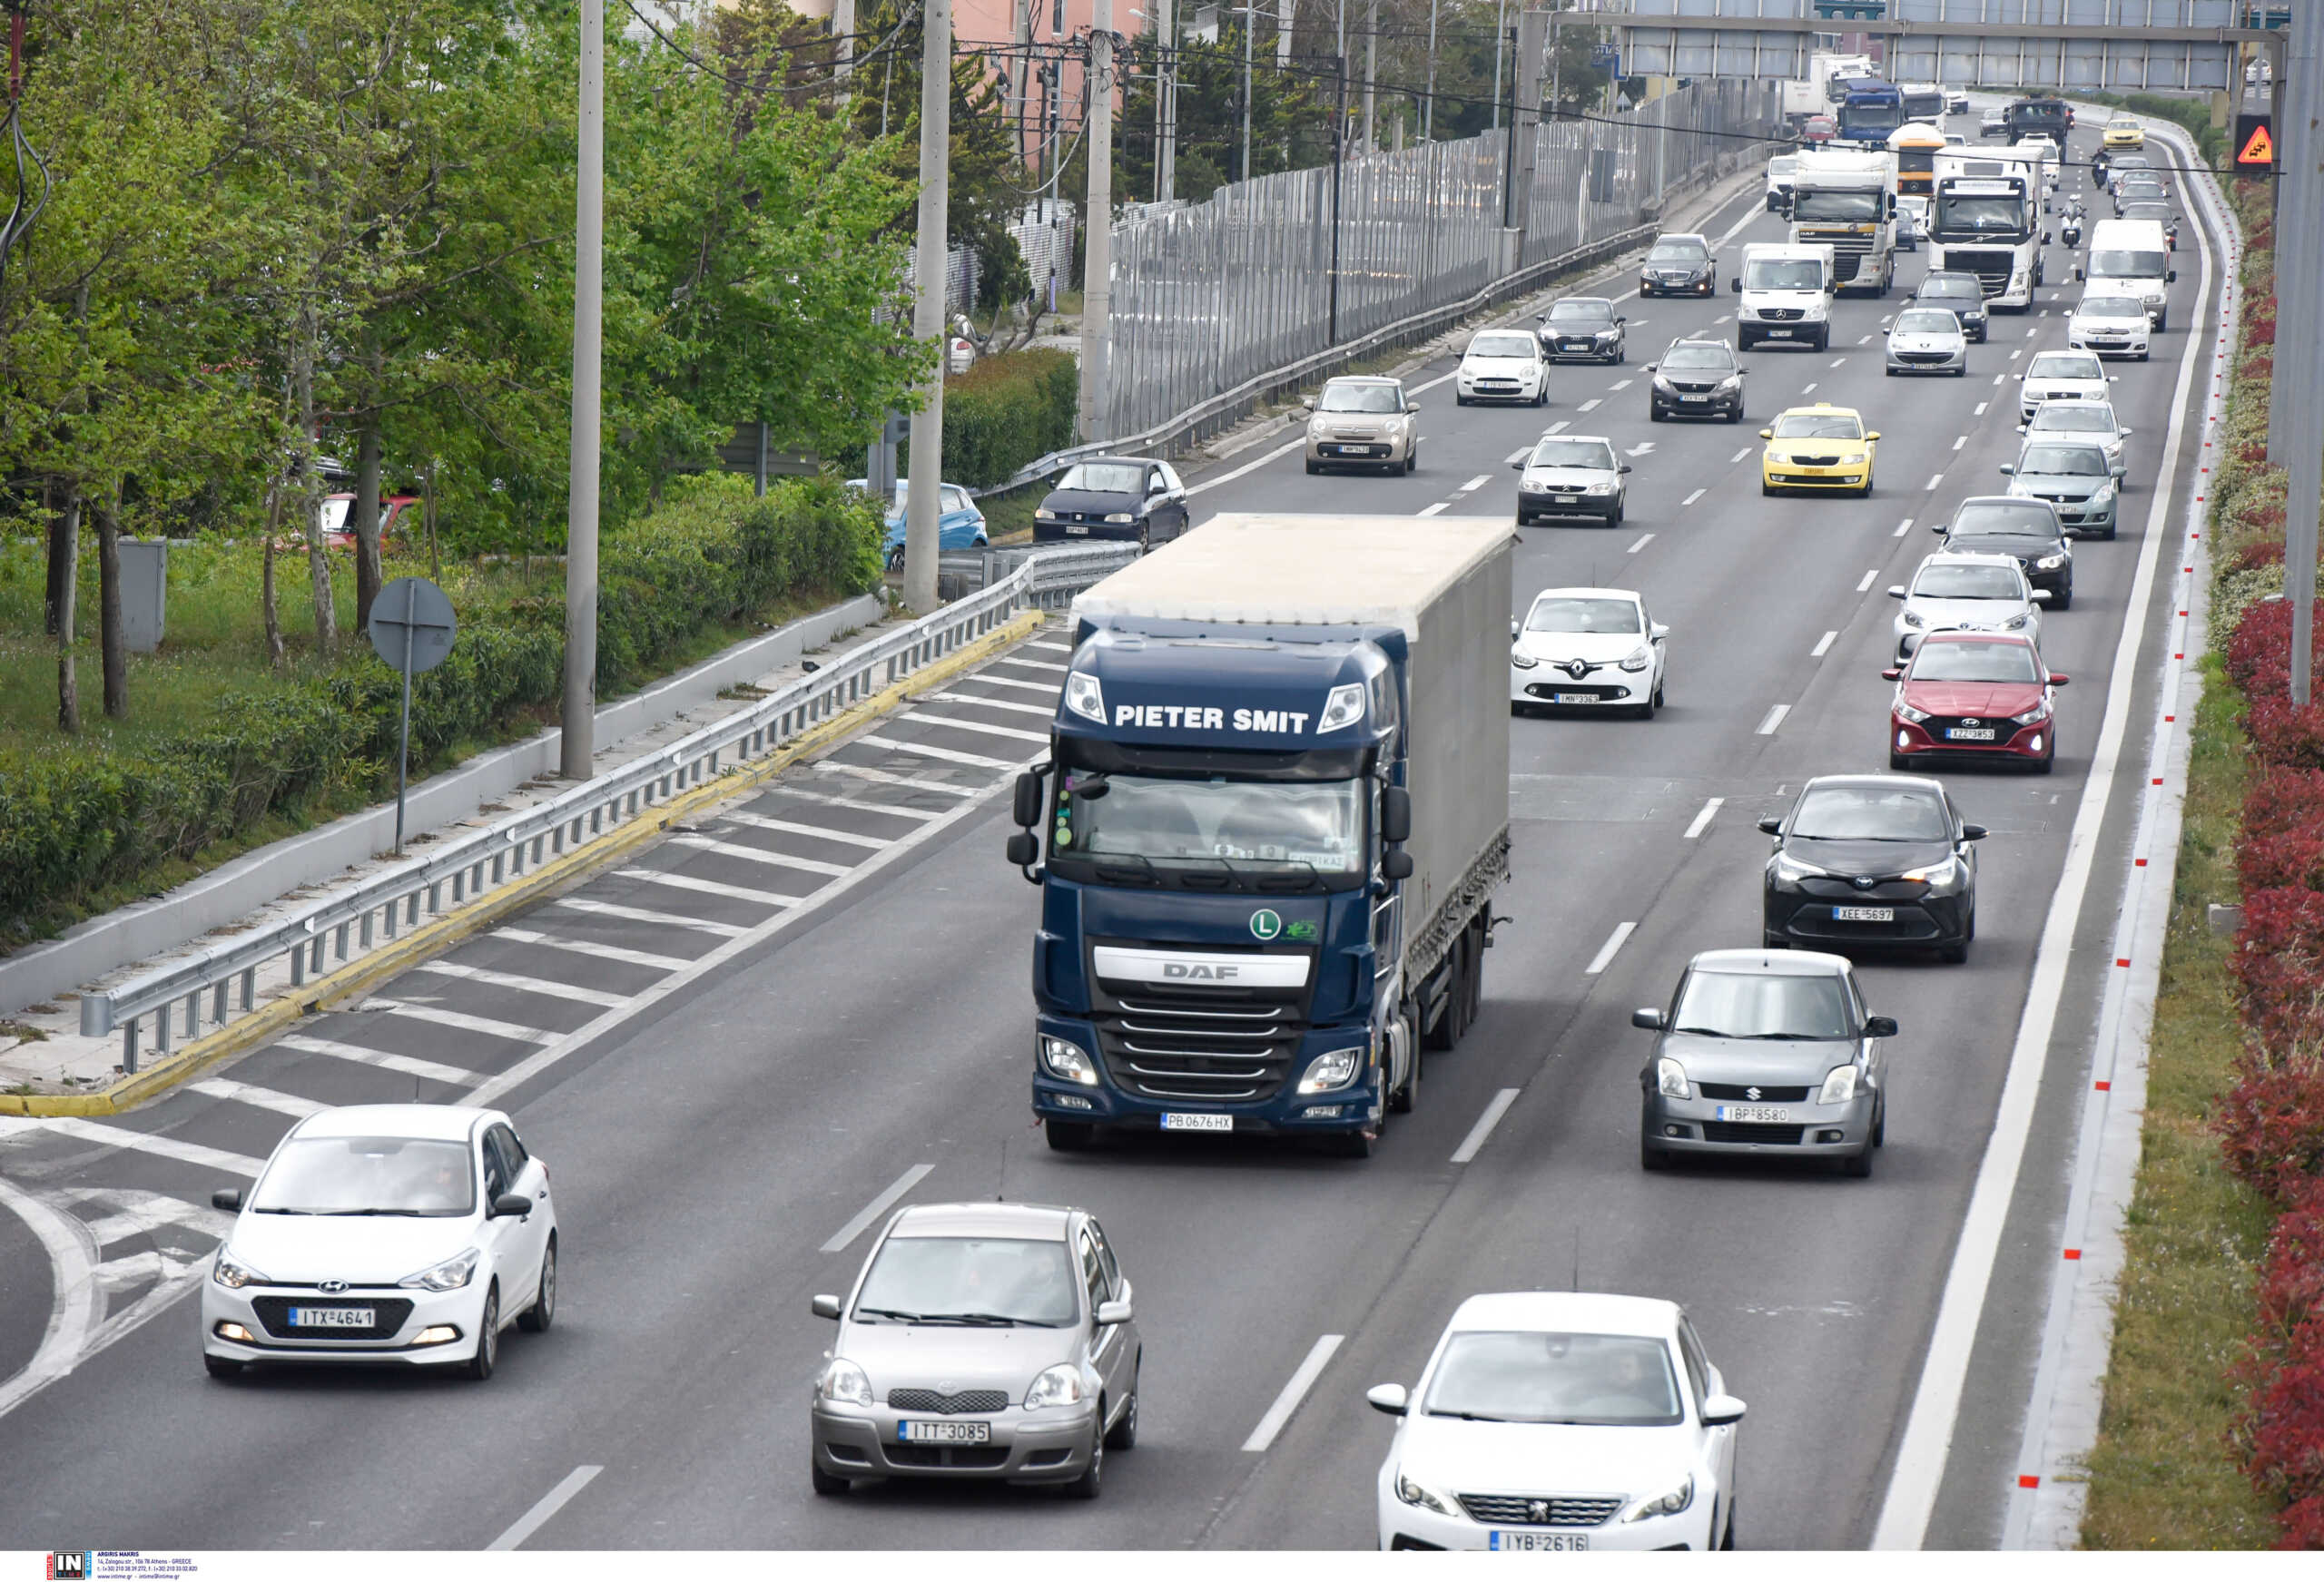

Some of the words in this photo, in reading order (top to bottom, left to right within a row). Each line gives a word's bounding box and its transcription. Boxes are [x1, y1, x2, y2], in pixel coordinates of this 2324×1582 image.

[1115, 705, 1224, 729] PIETER
[1233, 709, 1309, 734] SMIT
[1259, 914, 1273, 933] L
[1164, 963, 1238, 979] DAF
[1169, 1115, 1184, 1126] PB
[1186, 1116, 1213, 1127] 0676
[1215, 1117, 1230, 1128] HX
